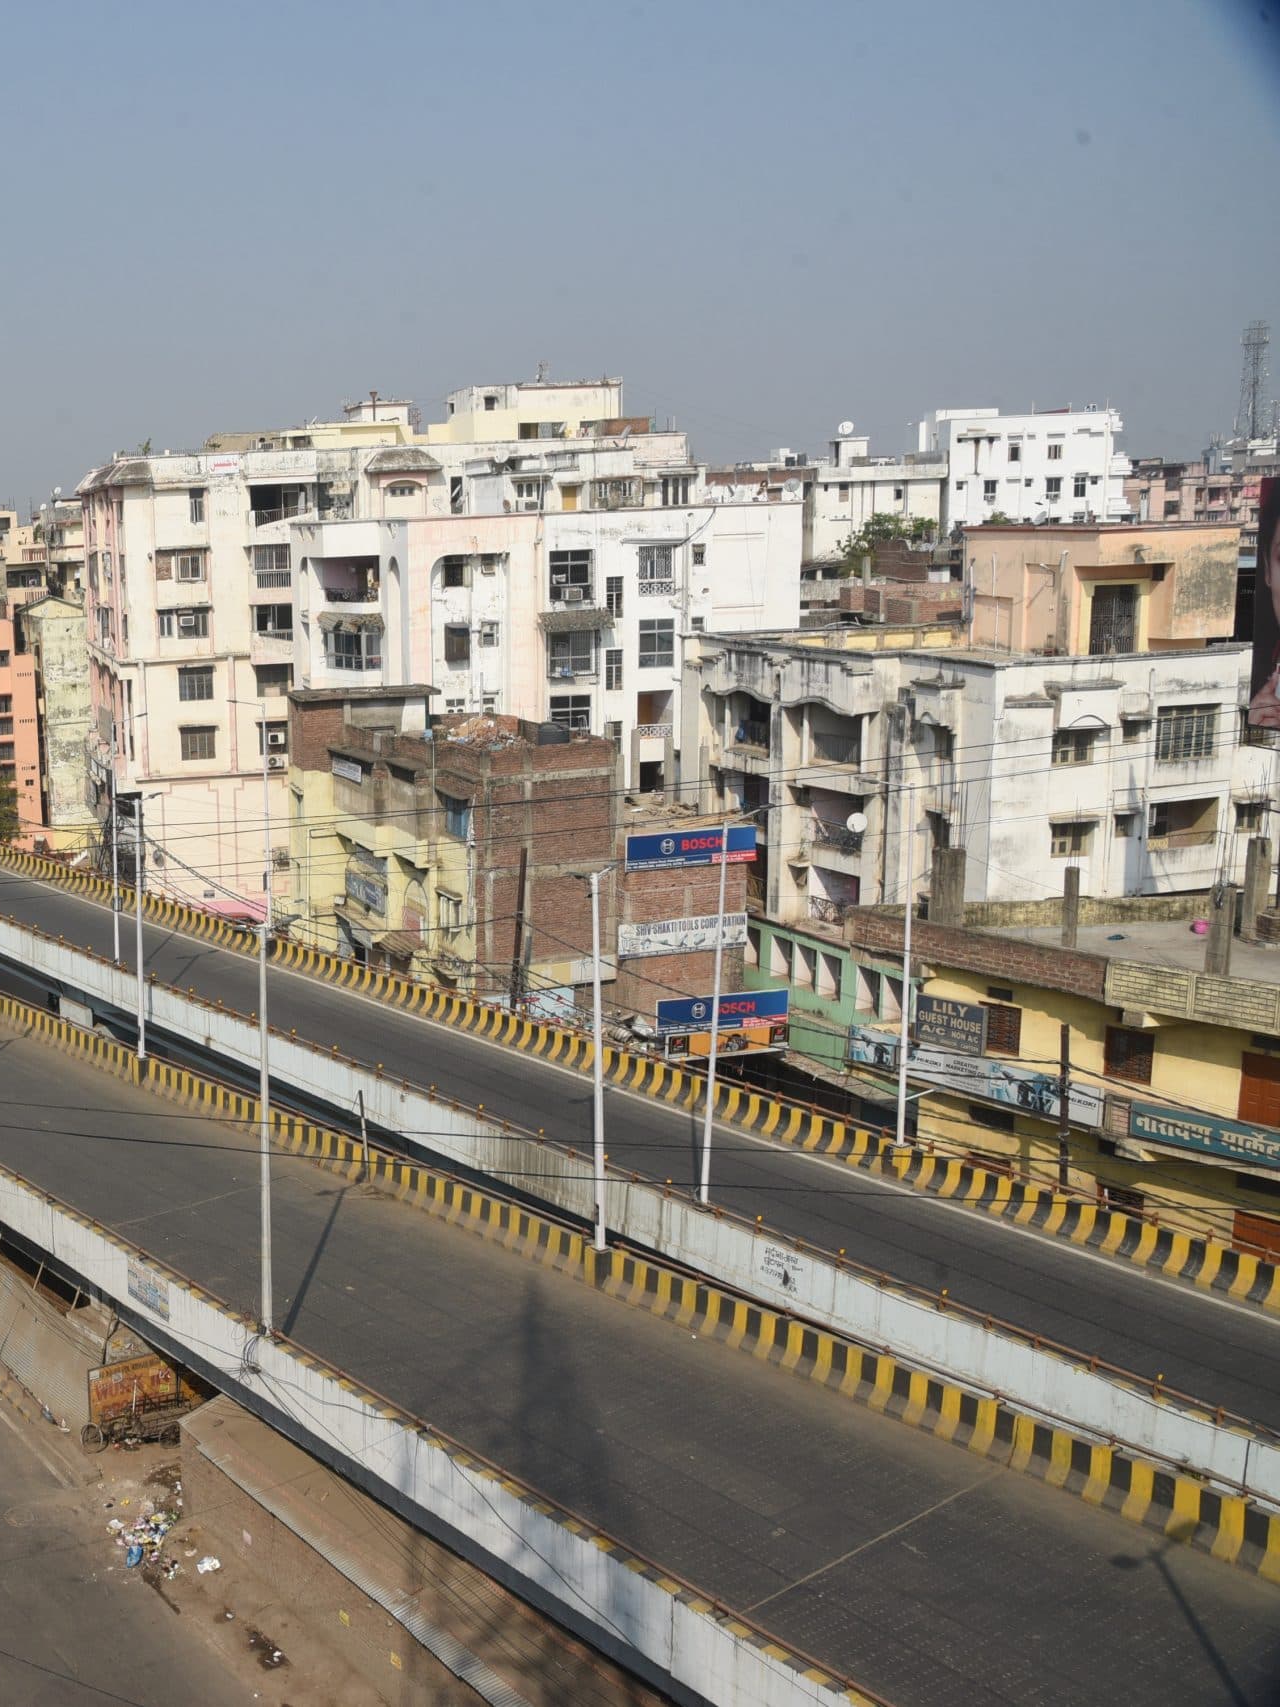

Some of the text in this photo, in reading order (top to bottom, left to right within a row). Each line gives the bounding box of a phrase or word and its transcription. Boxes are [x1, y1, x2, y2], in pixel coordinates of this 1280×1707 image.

[681, 836, 723, 851] BOSCH
[679, 917, 699, 931] TOOLS
[700, 914, 746, 929] CORPRATION
[933, 1000, 968, 1018] LILY
[918, 1010, 982, 1034] GUEST HOUSE
[921, 1024, 946, 1036] A/C
[951, 1030, 966, 1041] NON
[953, 1059, 979, 1070] CREATIVE
[1136, 1113, 1213, 1146] नारायण
